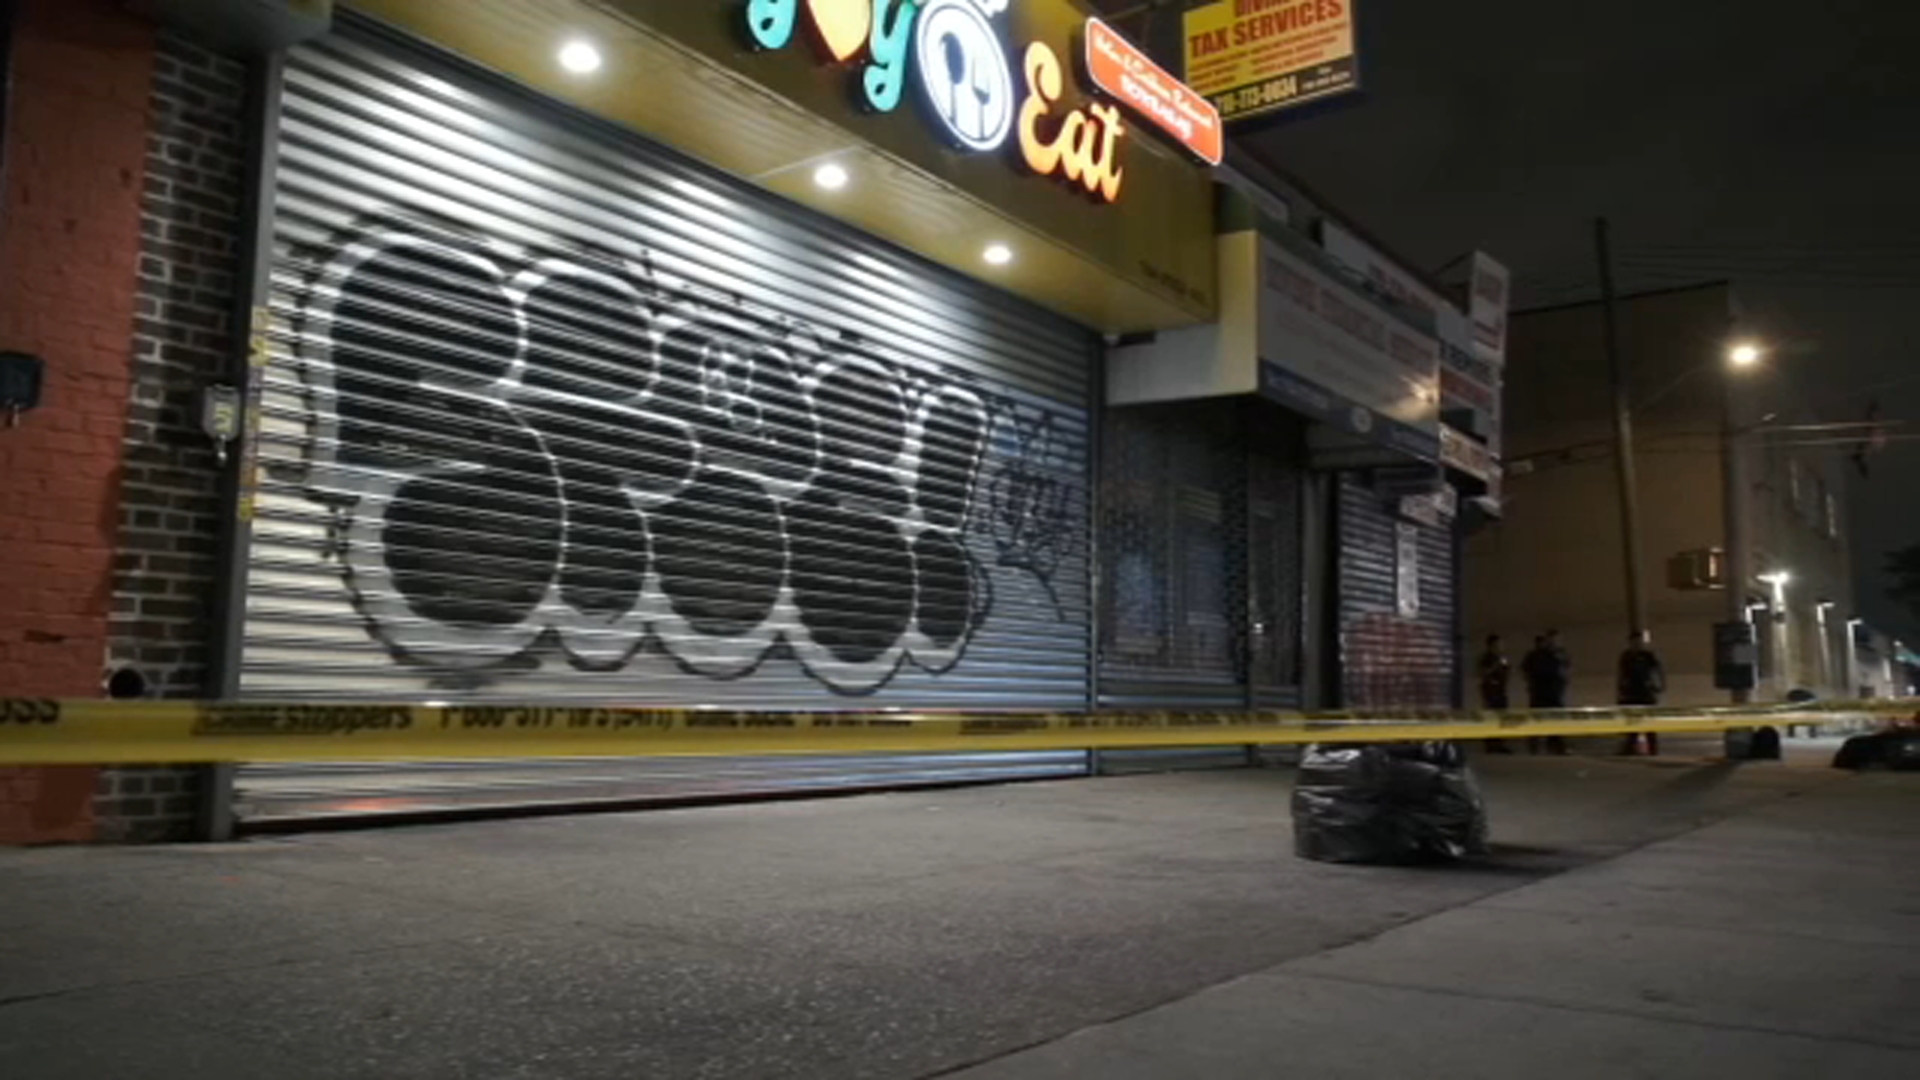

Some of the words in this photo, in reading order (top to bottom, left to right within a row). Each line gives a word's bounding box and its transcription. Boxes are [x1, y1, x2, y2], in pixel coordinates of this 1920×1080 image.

[1189, 27, 1229, 57] TAX
[1234, 0, 1343, 45] SERVICES
[1019, 41, 1125, 202] Eat
